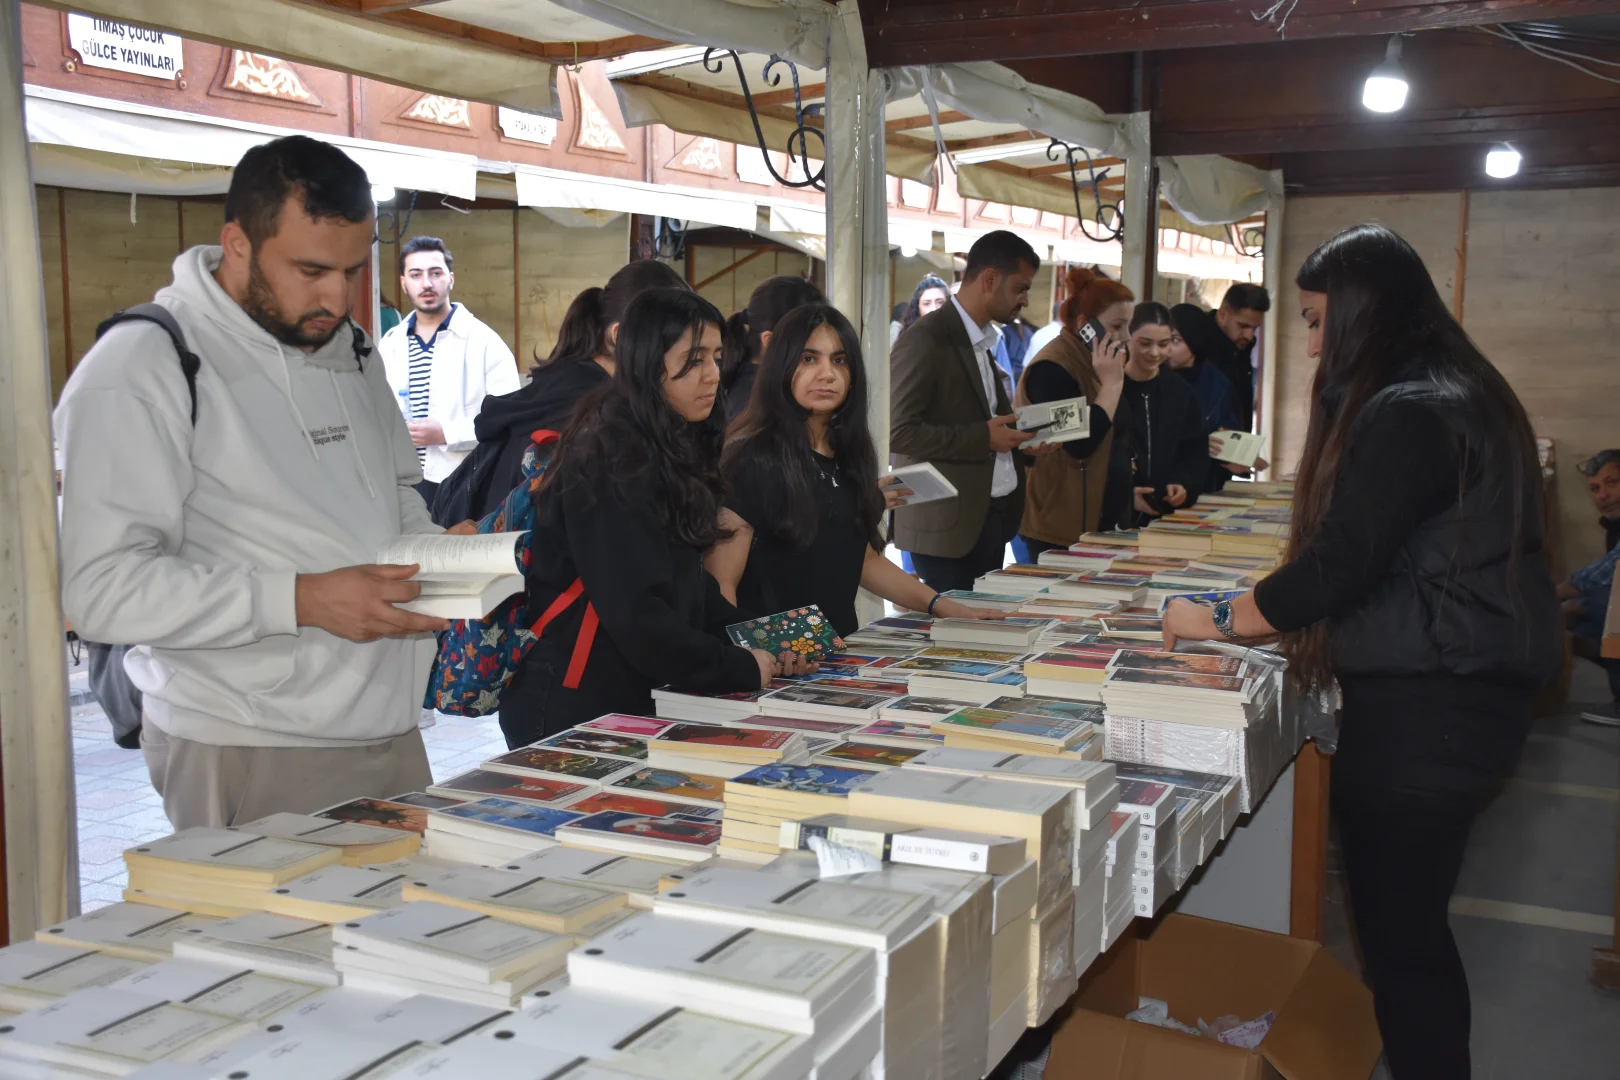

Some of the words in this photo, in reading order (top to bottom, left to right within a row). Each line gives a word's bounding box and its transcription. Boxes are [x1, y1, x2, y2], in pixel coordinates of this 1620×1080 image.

[128, 24, 165, 45] ÇOCUK
[82, 38, 117, 60] GÜLCE
[120, 48, 175, 71] YAYINLARI
